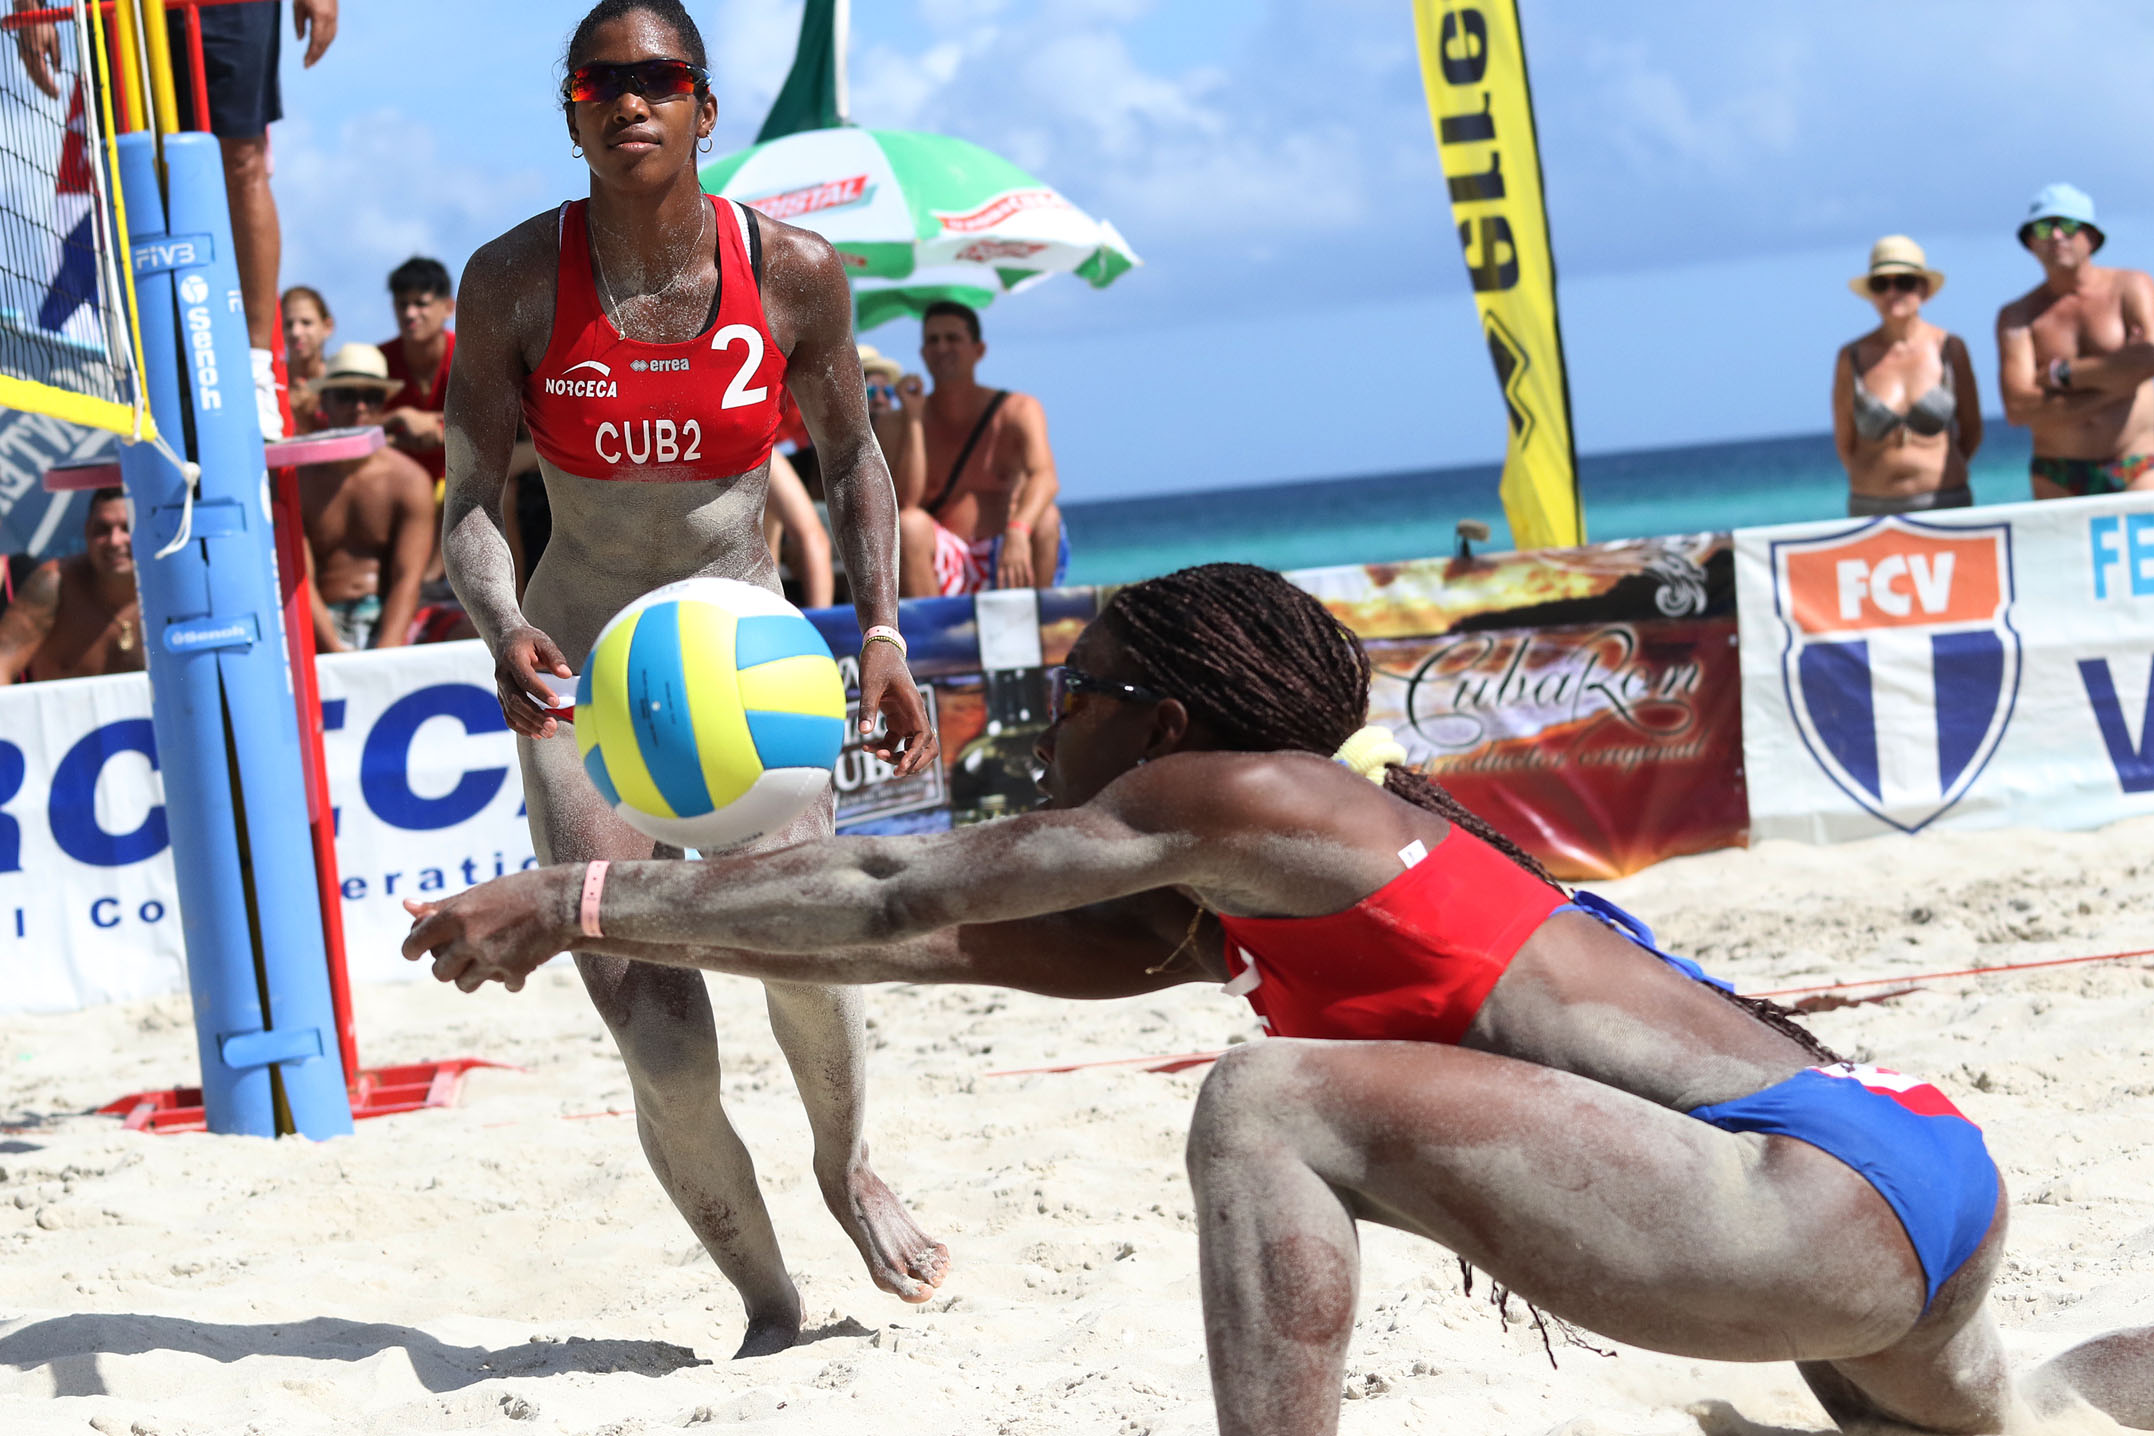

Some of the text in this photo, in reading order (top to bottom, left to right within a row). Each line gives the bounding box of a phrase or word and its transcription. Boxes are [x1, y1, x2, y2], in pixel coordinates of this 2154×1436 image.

[545, 378, 617, 398] NORCECA
[650, 358, 690, 372] errea
[711, 323, 768, 410] 2
[595, 418, 702, 464] CUB2
[1836, 550, 1956, 620] FCV
